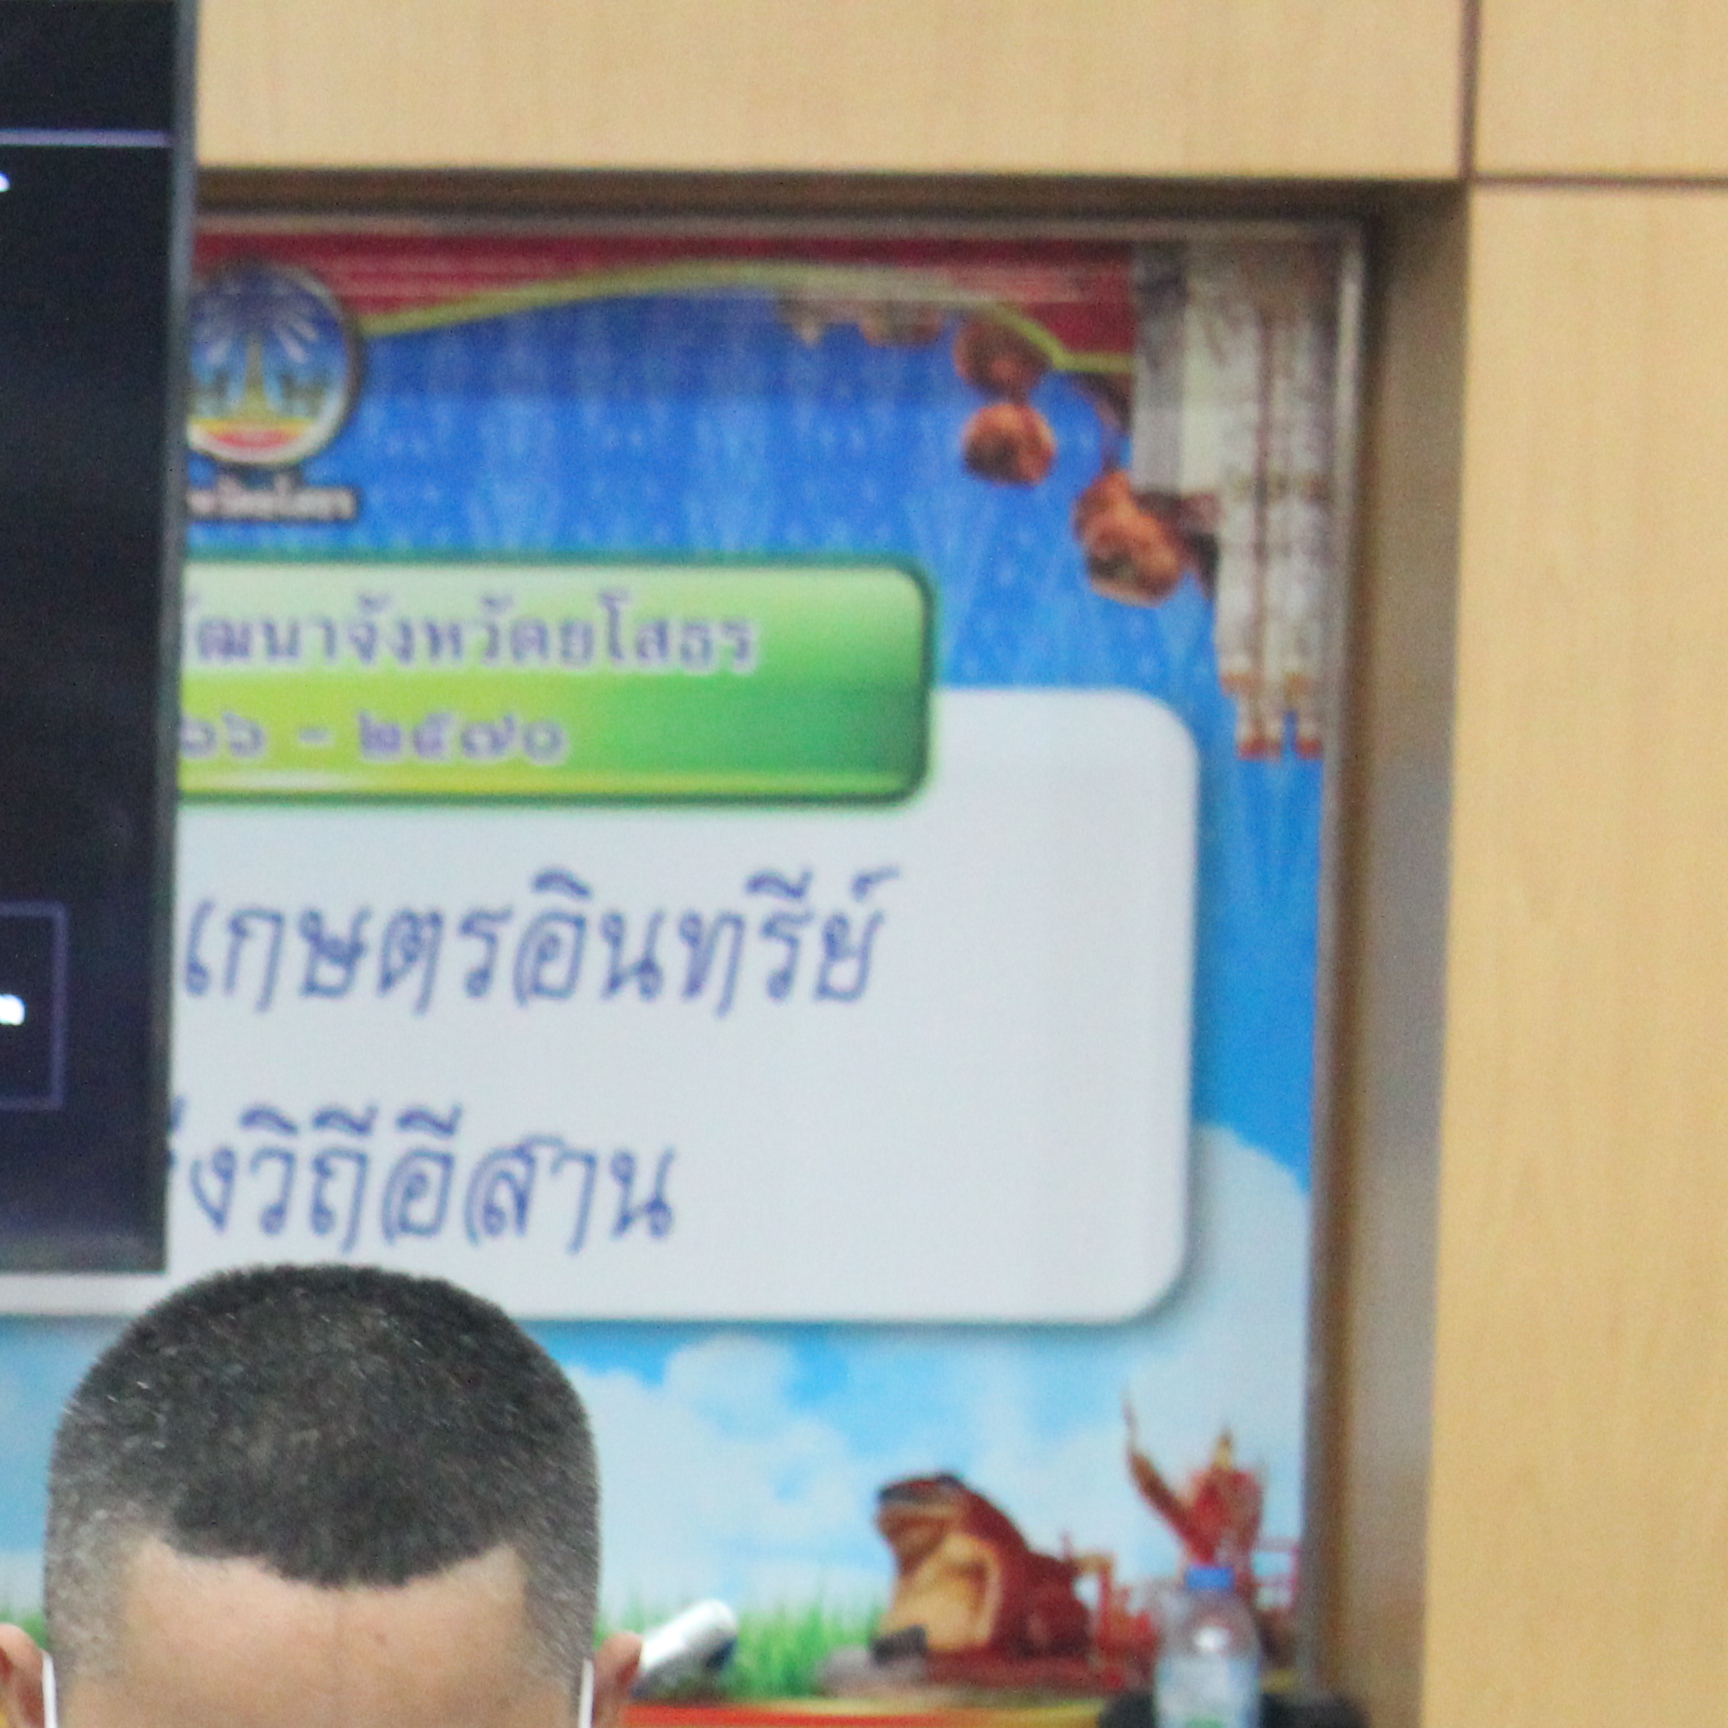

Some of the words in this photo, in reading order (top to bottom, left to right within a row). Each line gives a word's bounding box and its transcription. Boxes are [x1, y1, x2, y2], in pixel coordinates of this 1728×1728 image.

[183, 867, 900, 1018] เกษตรอินทรีย์
